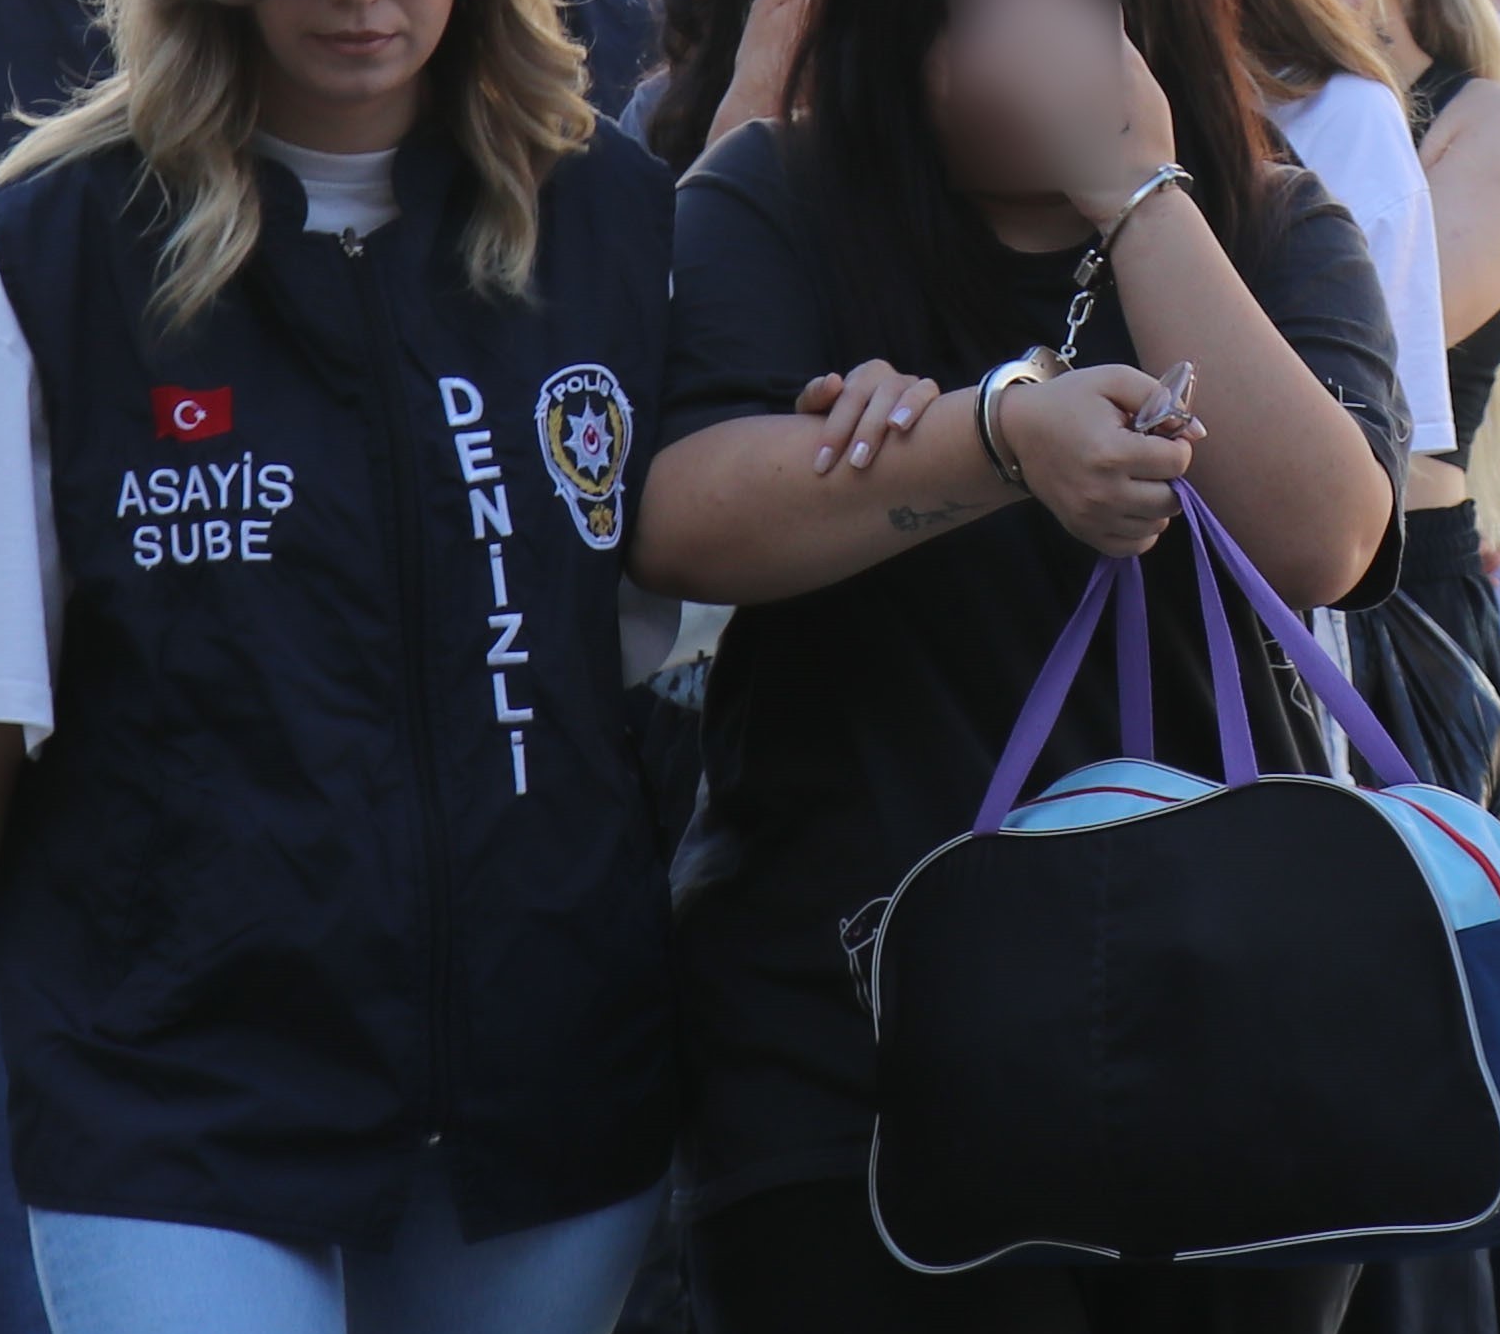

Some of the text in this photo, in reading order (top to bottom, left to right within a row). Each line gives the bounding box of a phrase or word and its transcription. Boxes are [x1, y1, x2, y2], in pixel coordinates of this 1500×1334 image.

[116, 451, 295, 518] ASAYİŞ
[132, 519, 273, 571] ŞUBE
[438, 376, 534, 796] DENİZLİ
